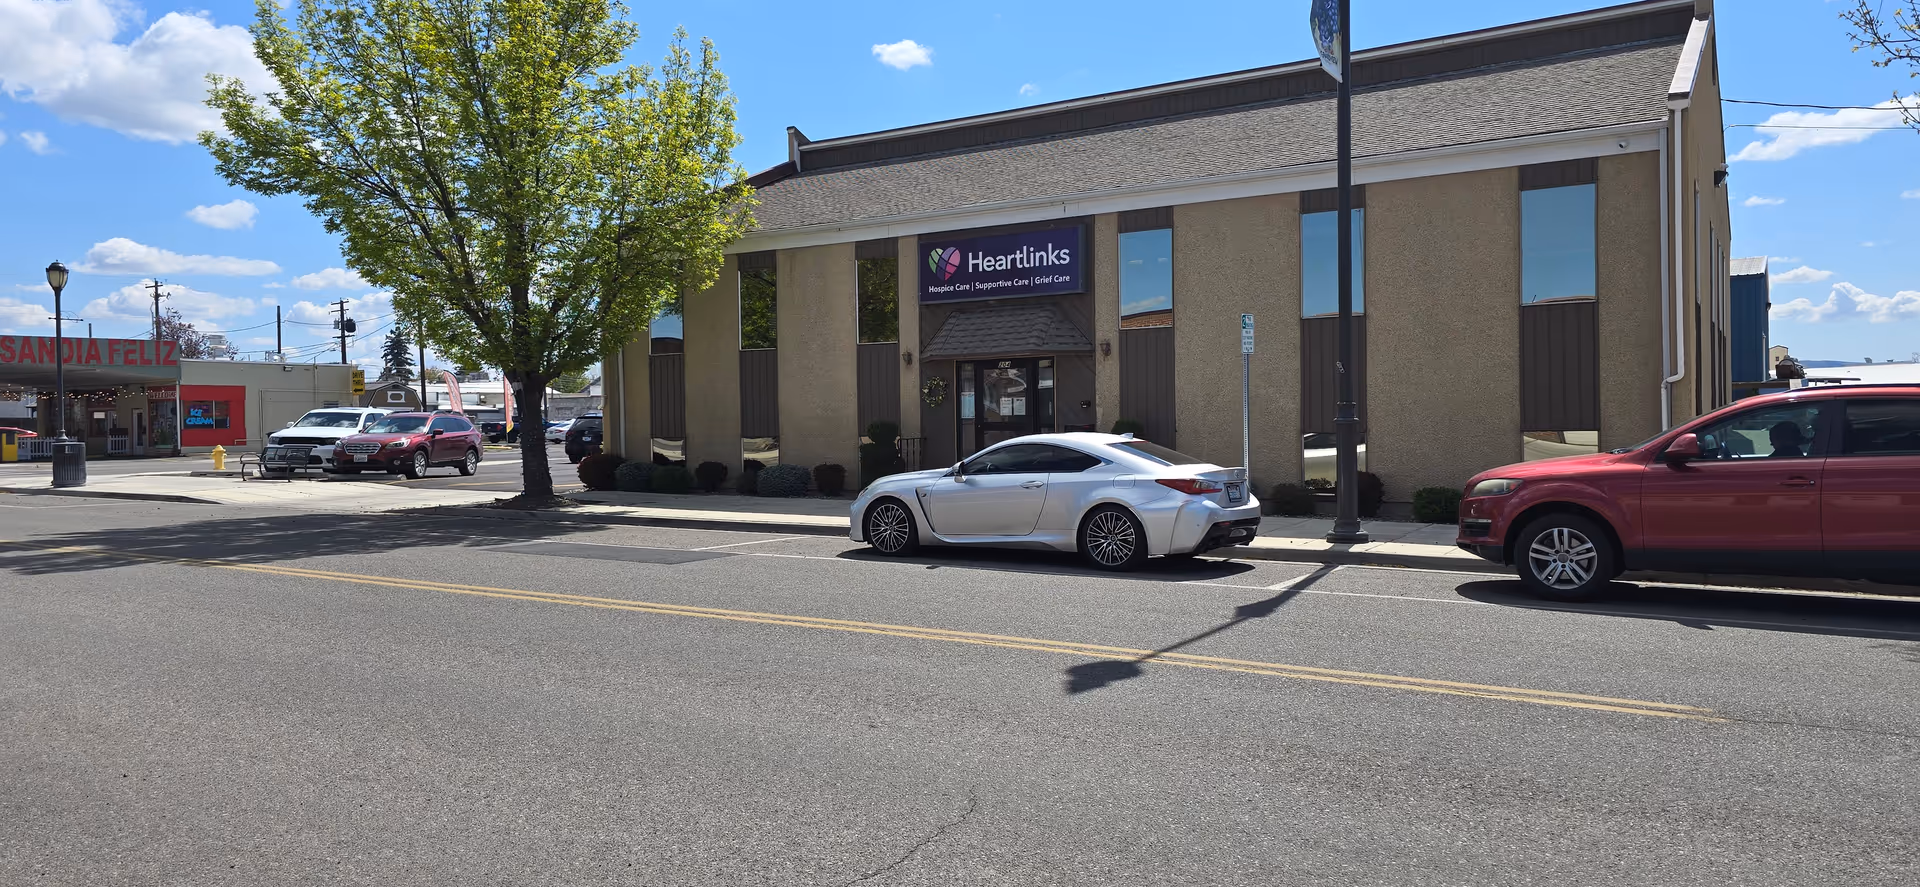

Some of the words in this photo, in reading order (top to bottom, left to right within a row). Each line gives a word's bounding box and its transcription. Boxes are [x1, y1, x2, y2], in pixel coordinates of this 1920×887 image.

[968, 243, 1070, 273] Heartlinks
[928, 284, 954, 293] Hospice
[955, 283, 970, 291] Care
[975, 279, 1012, 290] Supportive
[1013, 277, 1029, 286] Care
[1034, 275, 1052, 284] Grief
[1053, 274, 1071, 282] Care
[0, 335, 104, 364] SANDIA
[108, 338, 178, 366] FELIZ
[185, 417, 214, 425] CREAM
[190, 408, 203, 416] ICE
